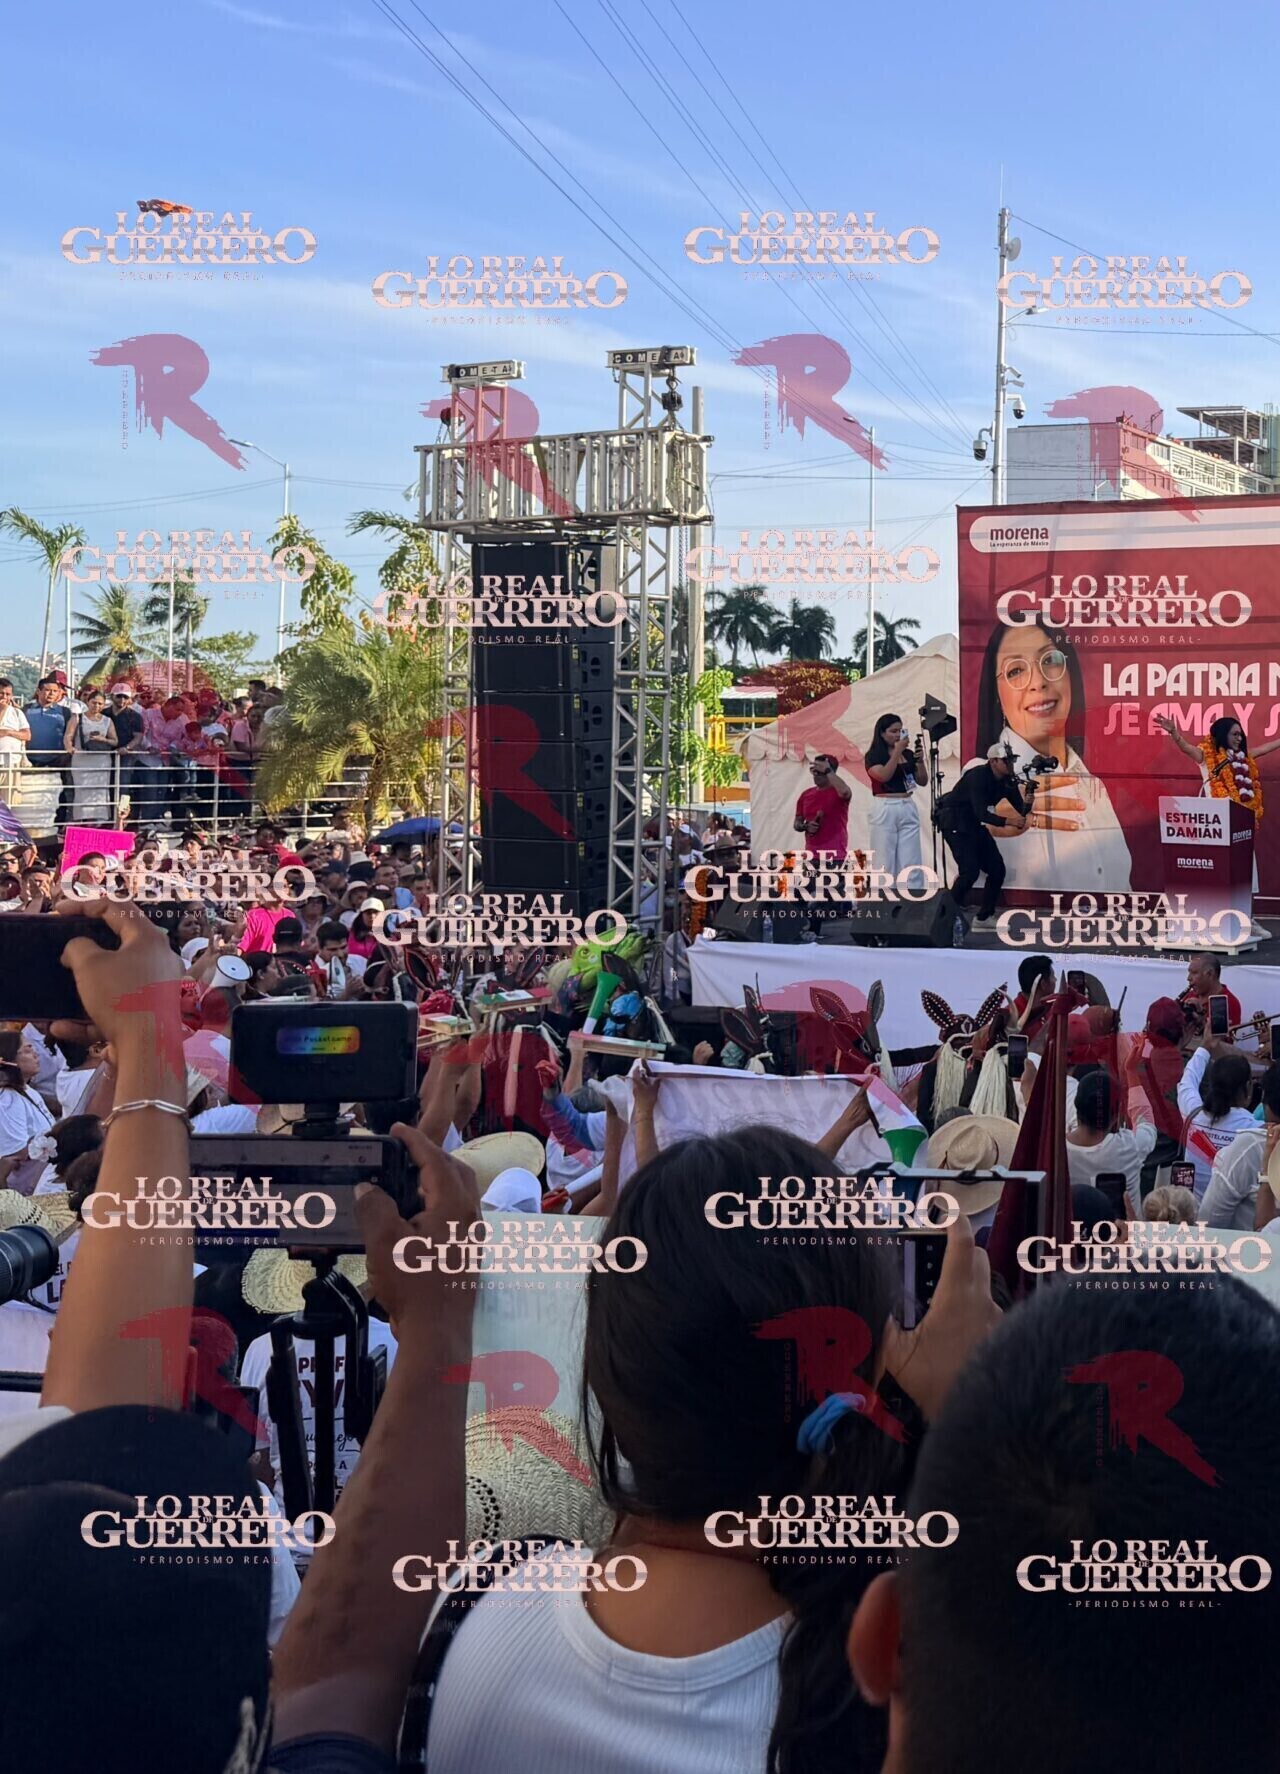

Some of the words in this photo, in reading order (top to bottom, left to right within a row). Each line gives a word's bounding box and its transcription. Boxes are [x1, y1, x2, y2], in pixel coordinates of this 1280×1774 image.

[614, 351, 681, 364] COMEA
[447, 364, 510, 378] OMETA
[989, 527, 1049, 541] morena
[1103, 662, 1139, 697] LA
[1147, 662, 1260, 697] PATRIA
[1104, 702, 1141, 736] SE
[1147, 702, 1225, 737] AMA
[1232, 702, 1256, 738] Y
[1165, 812, 1222, 825] ESTHELA
[1166, 823, 1223, 840] DAMIÁN
[1232, 829, 1252, 840] morena
[1177, 857, 1214, 867] morena
